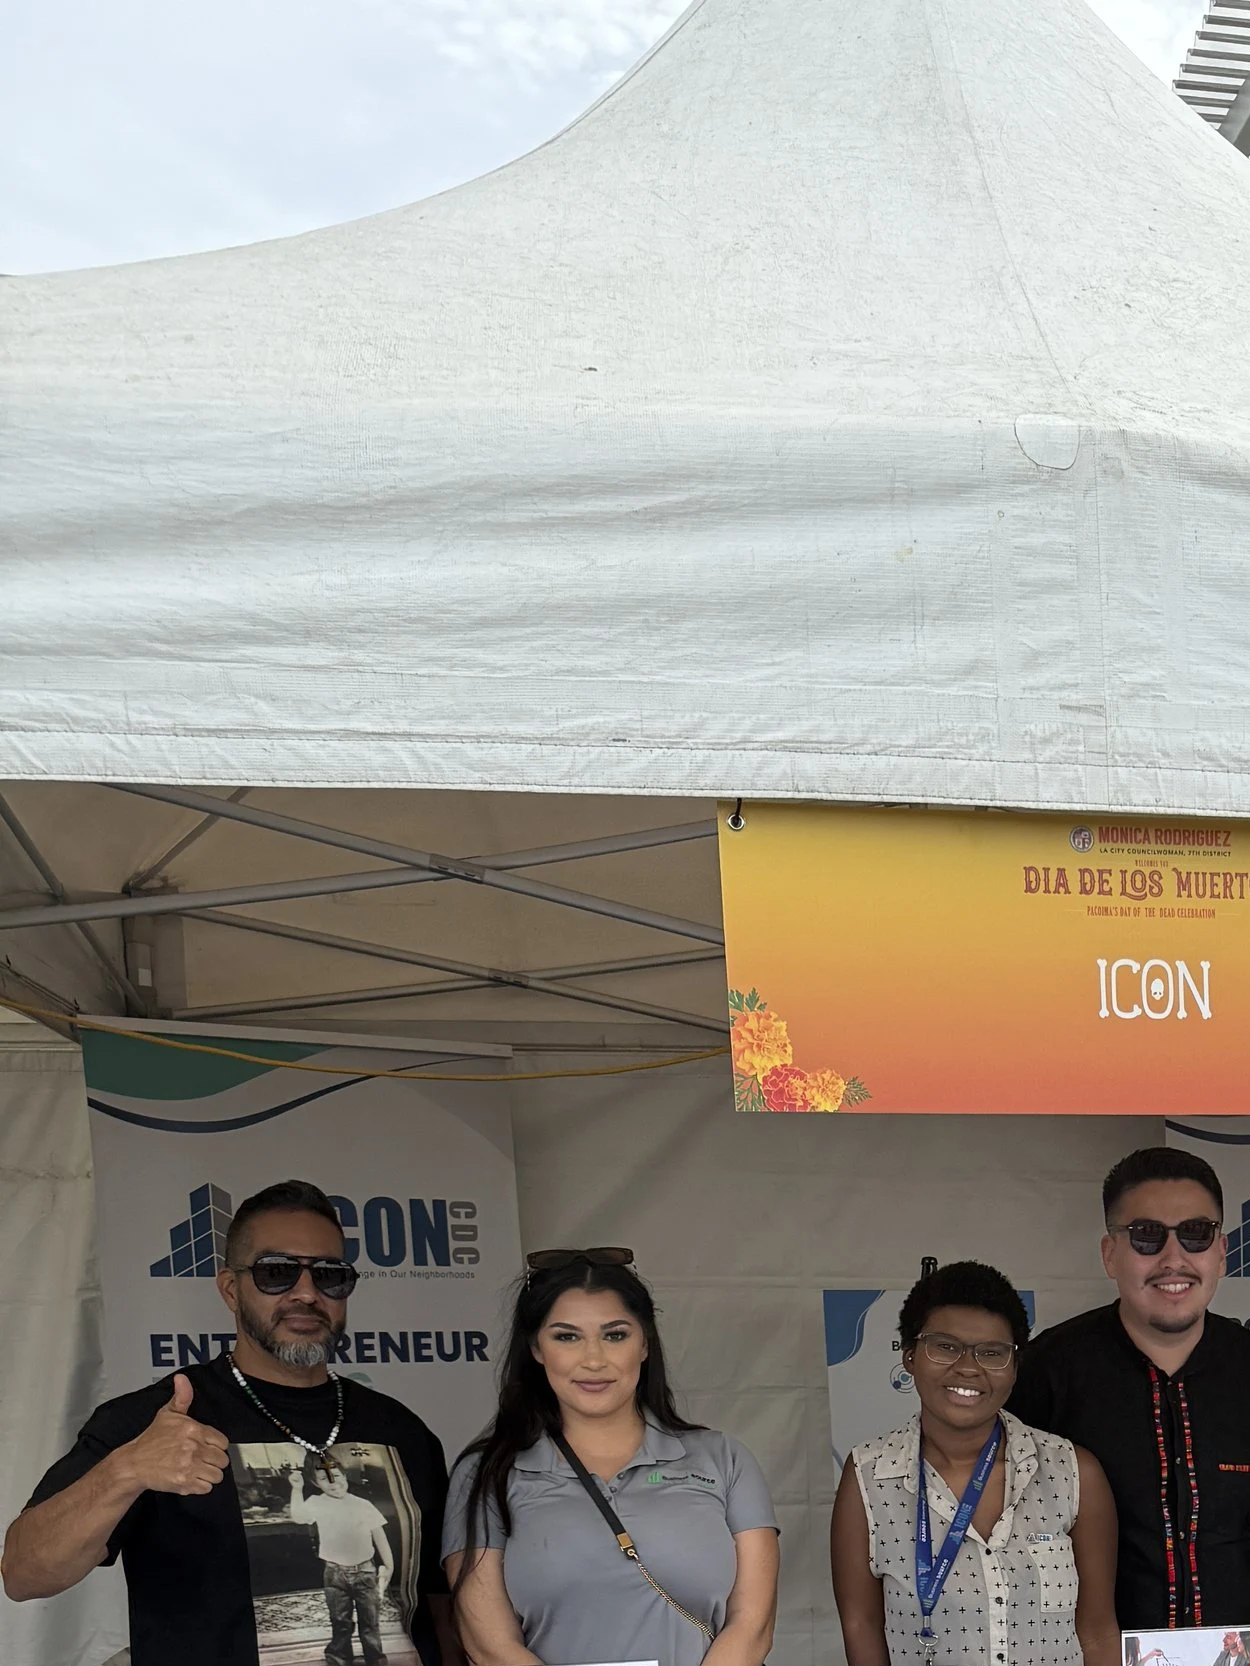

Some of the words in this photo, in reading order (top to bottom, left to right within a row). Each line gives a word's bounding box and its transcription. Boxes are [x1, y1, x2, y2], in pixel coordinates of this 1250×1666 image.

[1098, 826, 1149, 845] MONICA
[1155, 828, 1231, 847] RODRIGUEZ
[1023, 866, 1071, 895] DIA
[1078, 867, 1113, 897] DE
[1119, 869, 1164, 901] LOS
[1120, 907, 1132, 917] DAY
[1133, 907, 1141, 918] OF
[1144, 907, 1156, 918] THE
[1159, 907, 1176, 918] DEAD
[1177, 908, 1216, 919] CELEBRATION
[1096, 958, 1212, 1020] ICON
[325, 1195, 451, 1268] CON
[449, 1201, 480, 1265] CDC
[379, 1270, 387, 1278] in
[390, 1270, 407, 1279] Our
[410, 1270, 475, 1280] Neighborhoods
